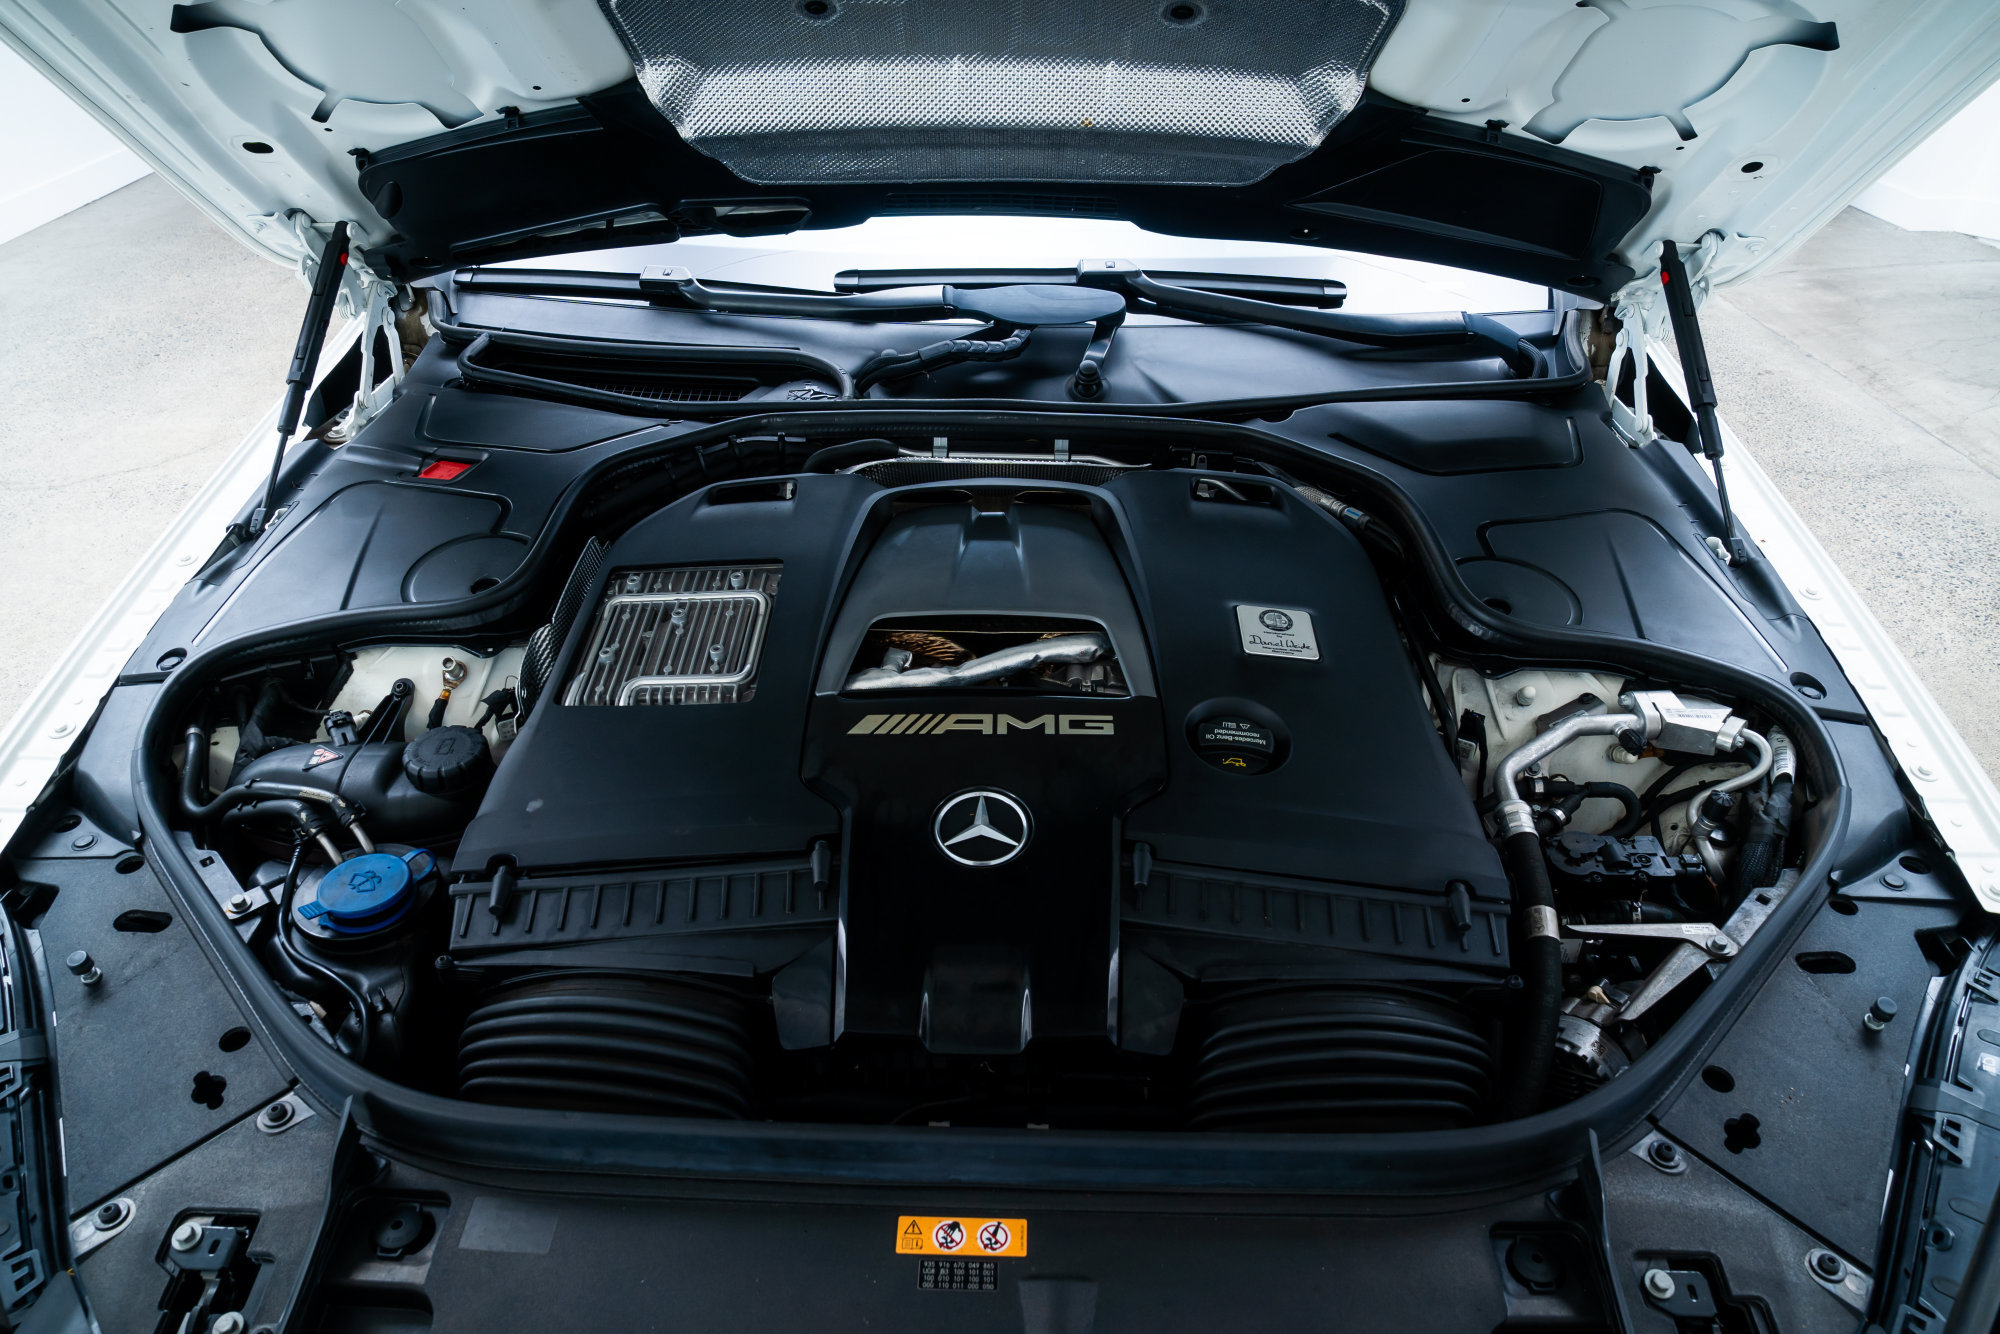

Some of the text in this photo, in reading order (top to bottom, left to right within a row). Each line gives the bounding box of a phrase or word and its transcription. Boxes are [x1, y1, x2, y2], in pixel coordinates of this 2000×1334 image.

[931, 713, 1115, 735] AMG
[1214, 728, 1260, 738] recommended
[1216, 734, 1266, 745] Mercedes-Benz
